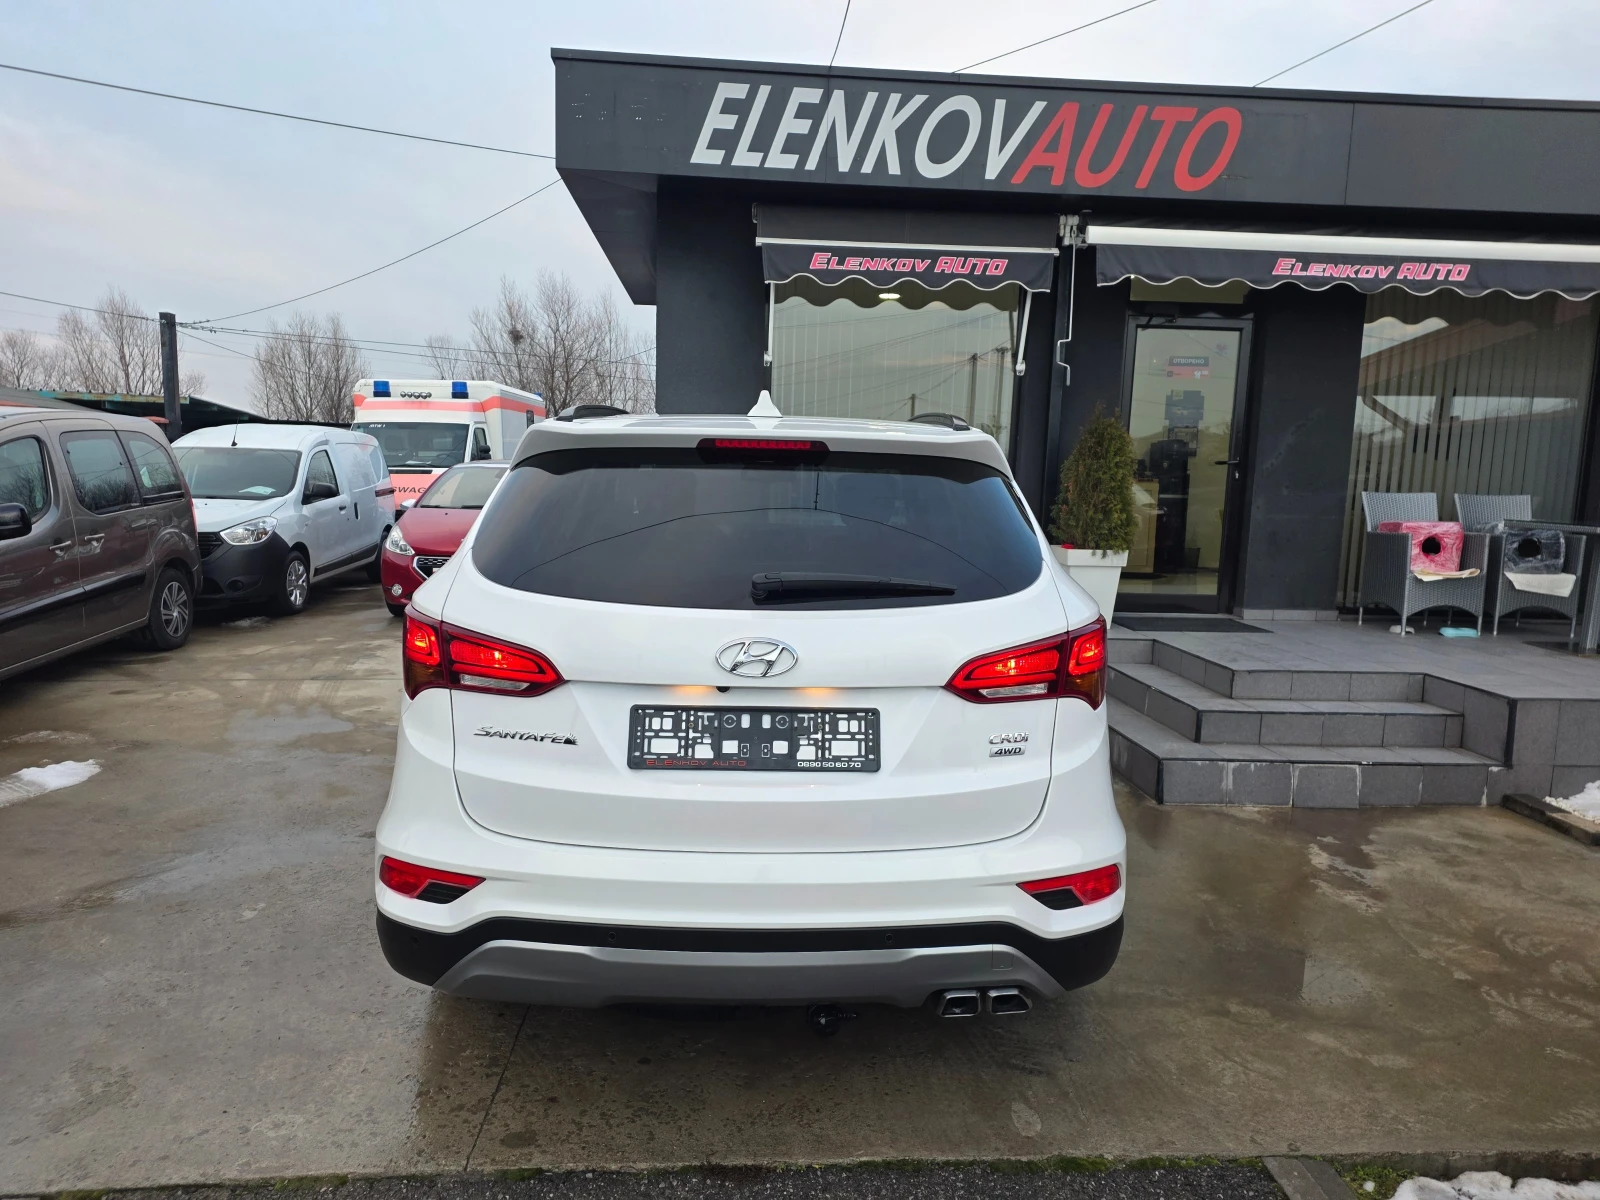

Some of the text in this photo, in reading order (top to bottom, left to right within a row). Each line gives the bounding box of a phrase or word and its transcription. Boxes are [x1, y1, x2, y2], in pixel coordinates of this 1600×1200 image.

[809, 252, 1008, 276] ELENKOV AUTO
[1272, 258, 1470, 281] ELENKOV AUTO
[994, 746, 1022, 756] 4WD
